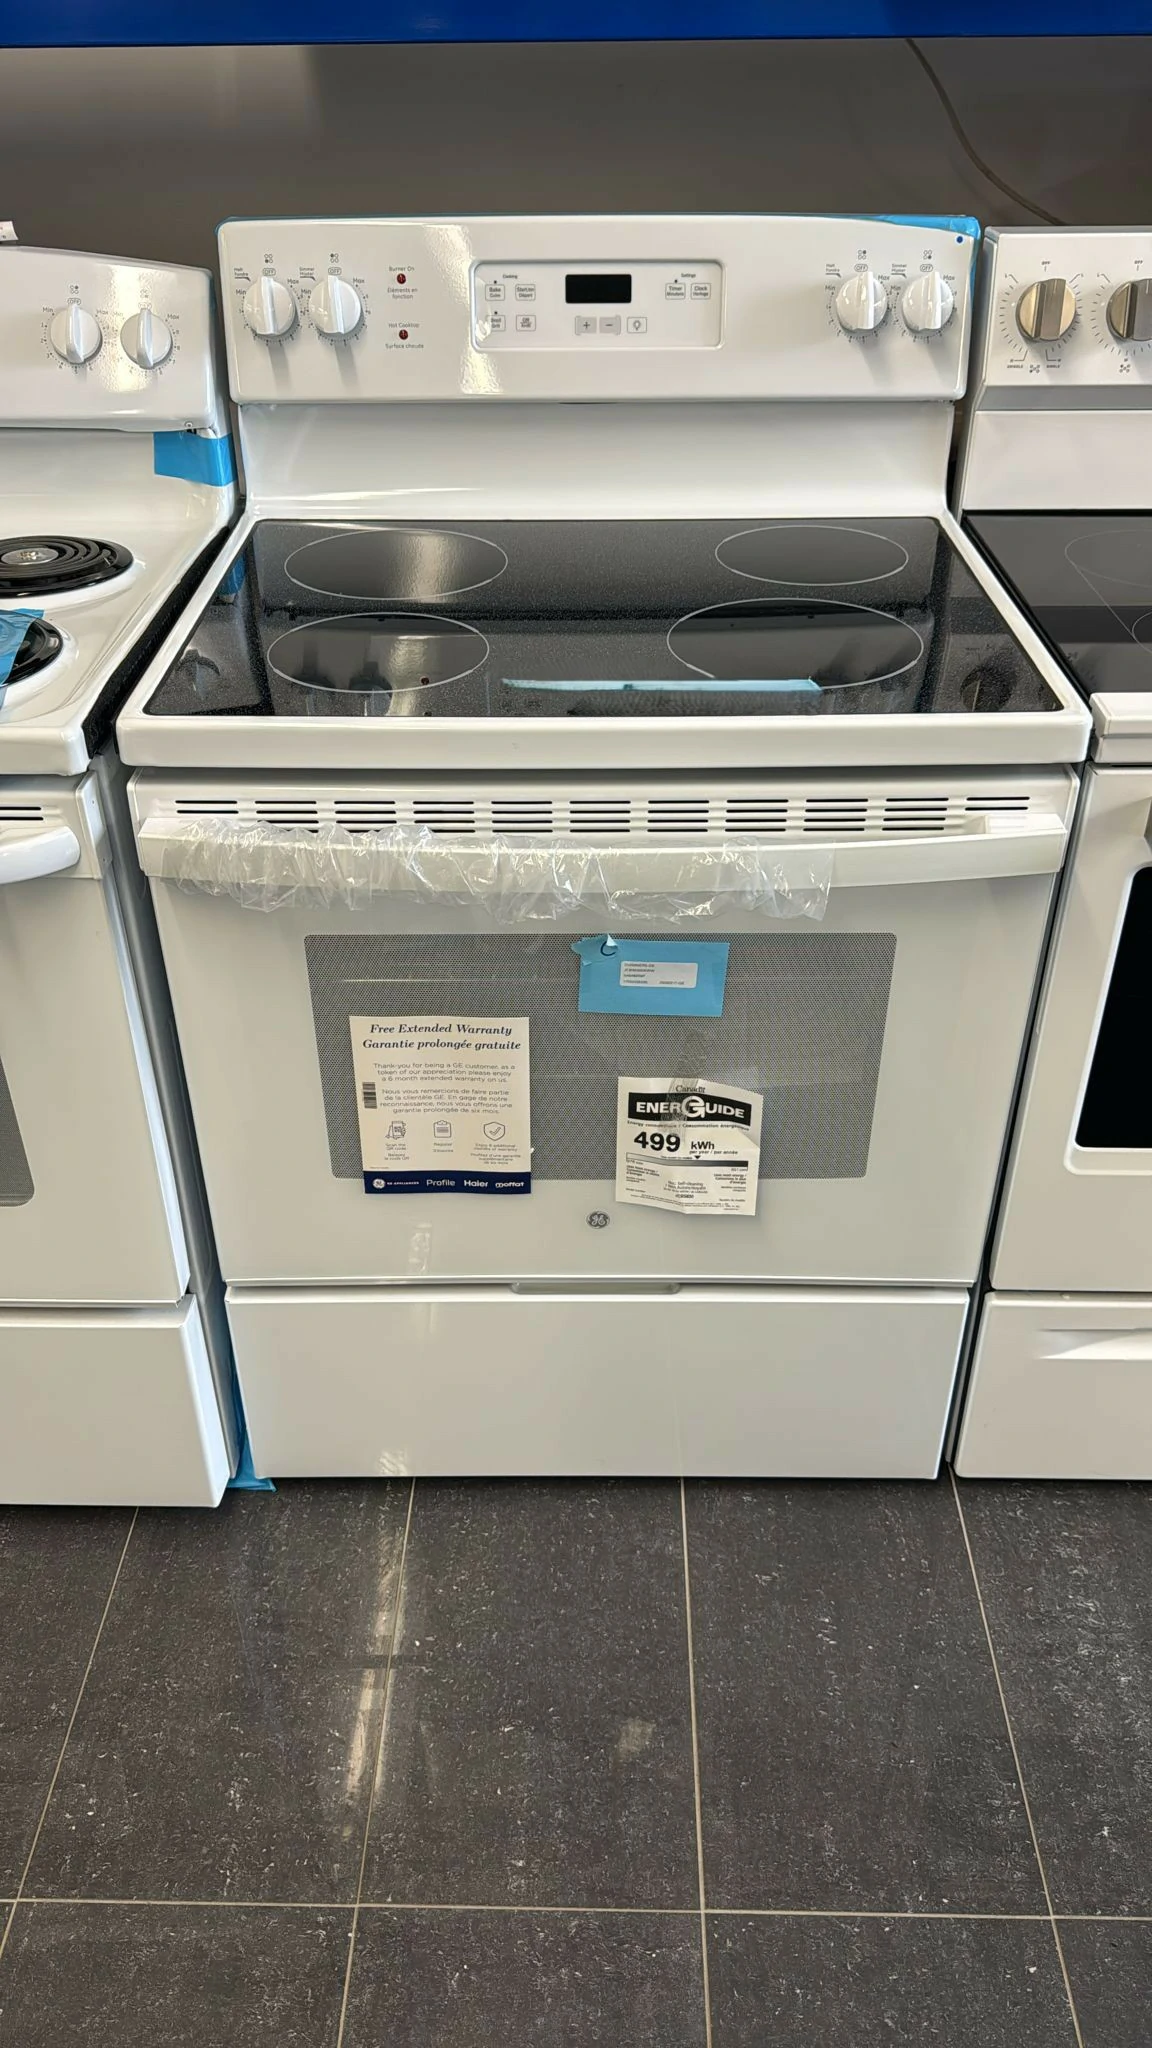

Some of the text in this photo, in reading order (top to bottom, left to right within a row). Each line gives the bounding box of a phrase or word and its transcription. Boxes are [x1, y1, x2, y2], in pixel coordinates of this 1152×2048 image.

[370, 1023, 512, 1036] Free Extended Warranty
[362, 1039, 521, 1051] Garantie prolongée gratuite
[636, 1095, 745, 1119] ENERGUIDE
[634, 1131, 681, 1152] 499
[690, 1141, 715, 1150] kWh
[426, 1179, 456, 1187] Profile
[463, 1179, 489, 1188] Haier
